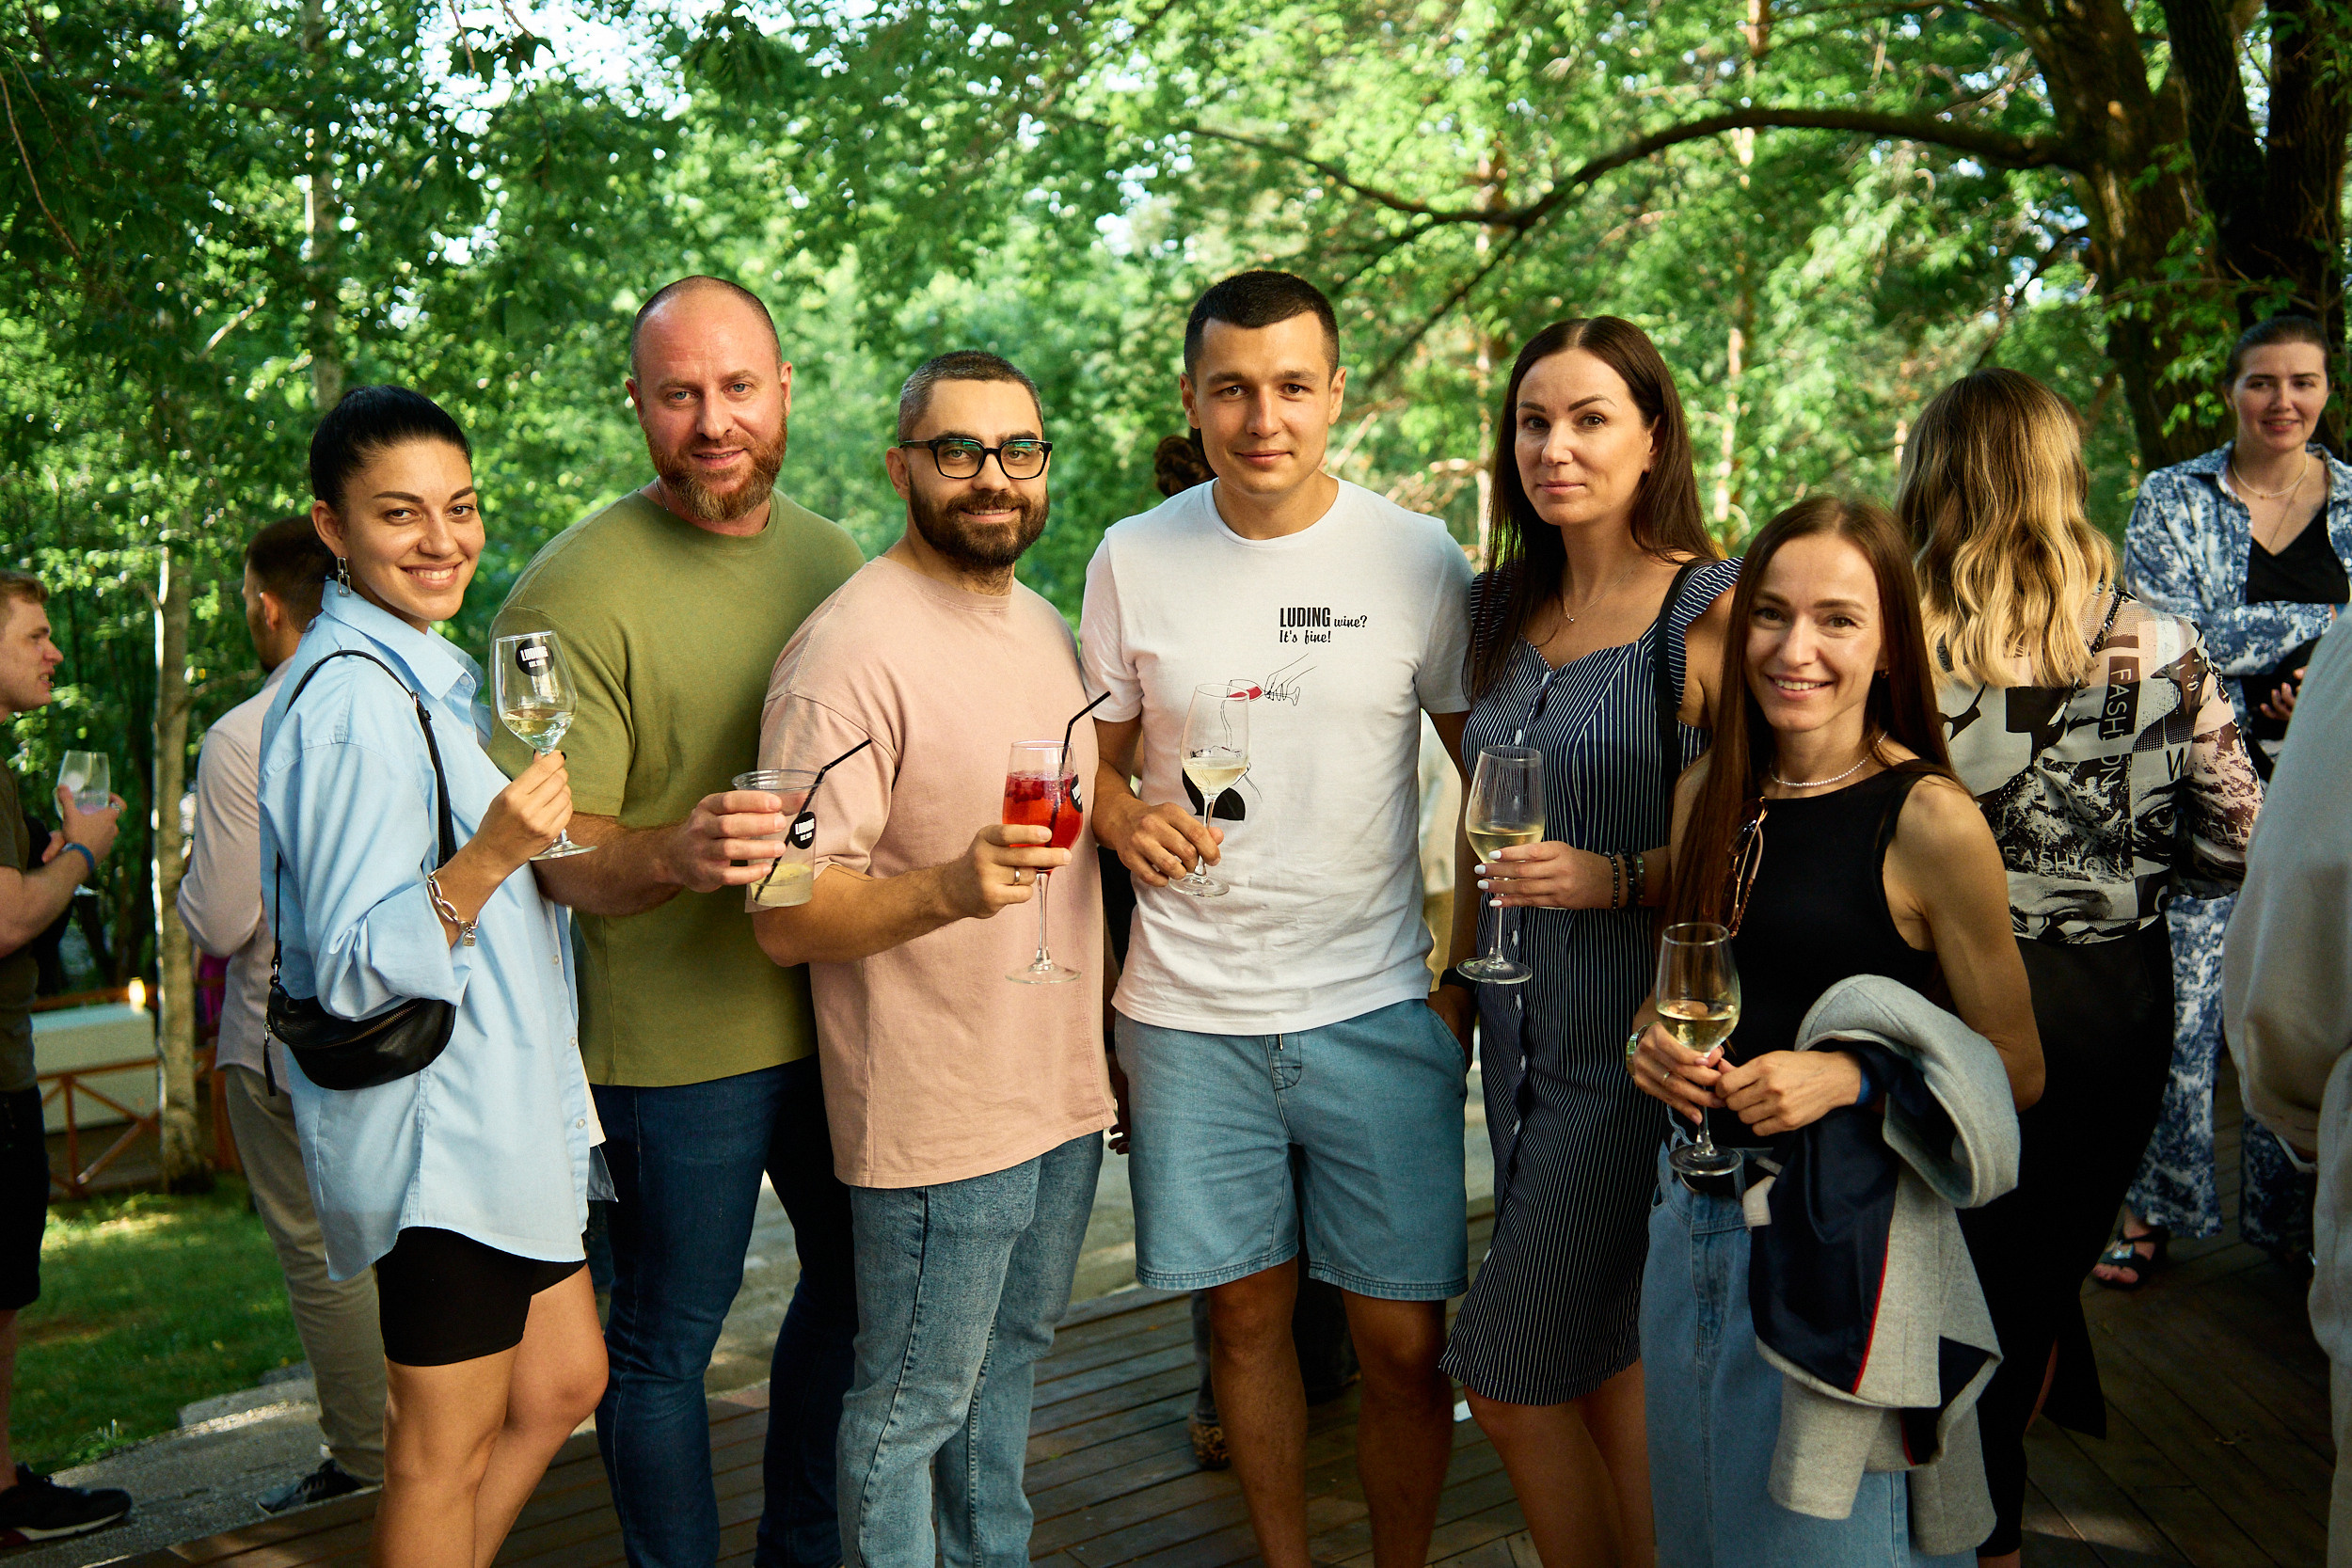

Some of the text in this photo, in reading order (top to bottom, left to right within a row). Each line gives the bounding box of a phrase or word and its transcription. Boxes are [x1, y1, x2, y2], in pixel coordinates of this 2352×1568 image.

[1279, 607, 1368, 628] LUDING wine?
[1279, 629, 1331, 644] It's fine!
